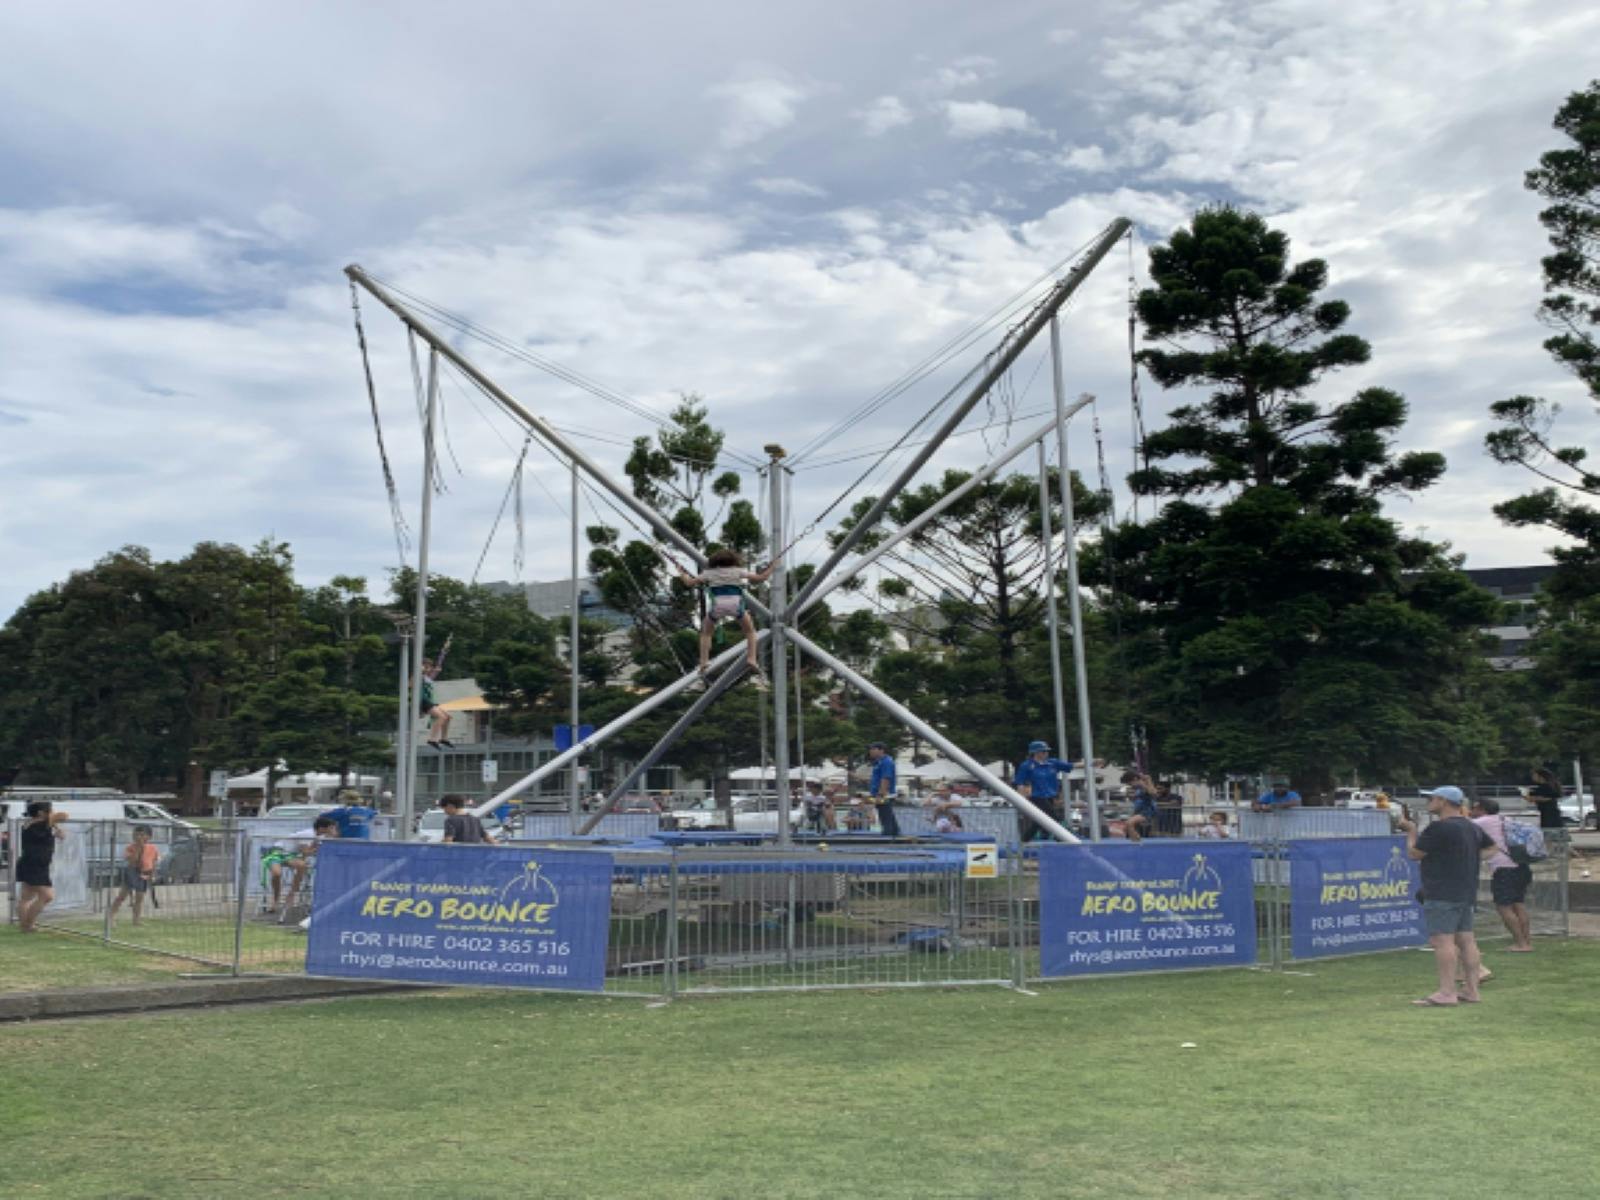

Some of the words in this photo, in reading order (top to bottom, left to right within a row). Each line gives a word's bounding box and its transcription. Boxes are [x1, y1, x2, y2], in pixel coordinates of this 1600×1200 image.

[361, 895, 433, 918] AERO
[440, 898, 556, 923] BOUNCE
[1081, 895, 1136, 917] AERO
[1141, 888, 1222, 913] BOUNCE
[1066, 931, 1102, 945] FOR
[1106, 928, 1143, 943] HIRE
[1148, 926, 1183, 941] 0402
[1312, 916, 1335, 930] FOR
[340, 931, 382, 947] FOR
[387, 933, 436, 950] HIRE
[443, 935, 493, 952] 0402
[498, 938, 533, 954] 365
[536, 941, 571, 956] 516
